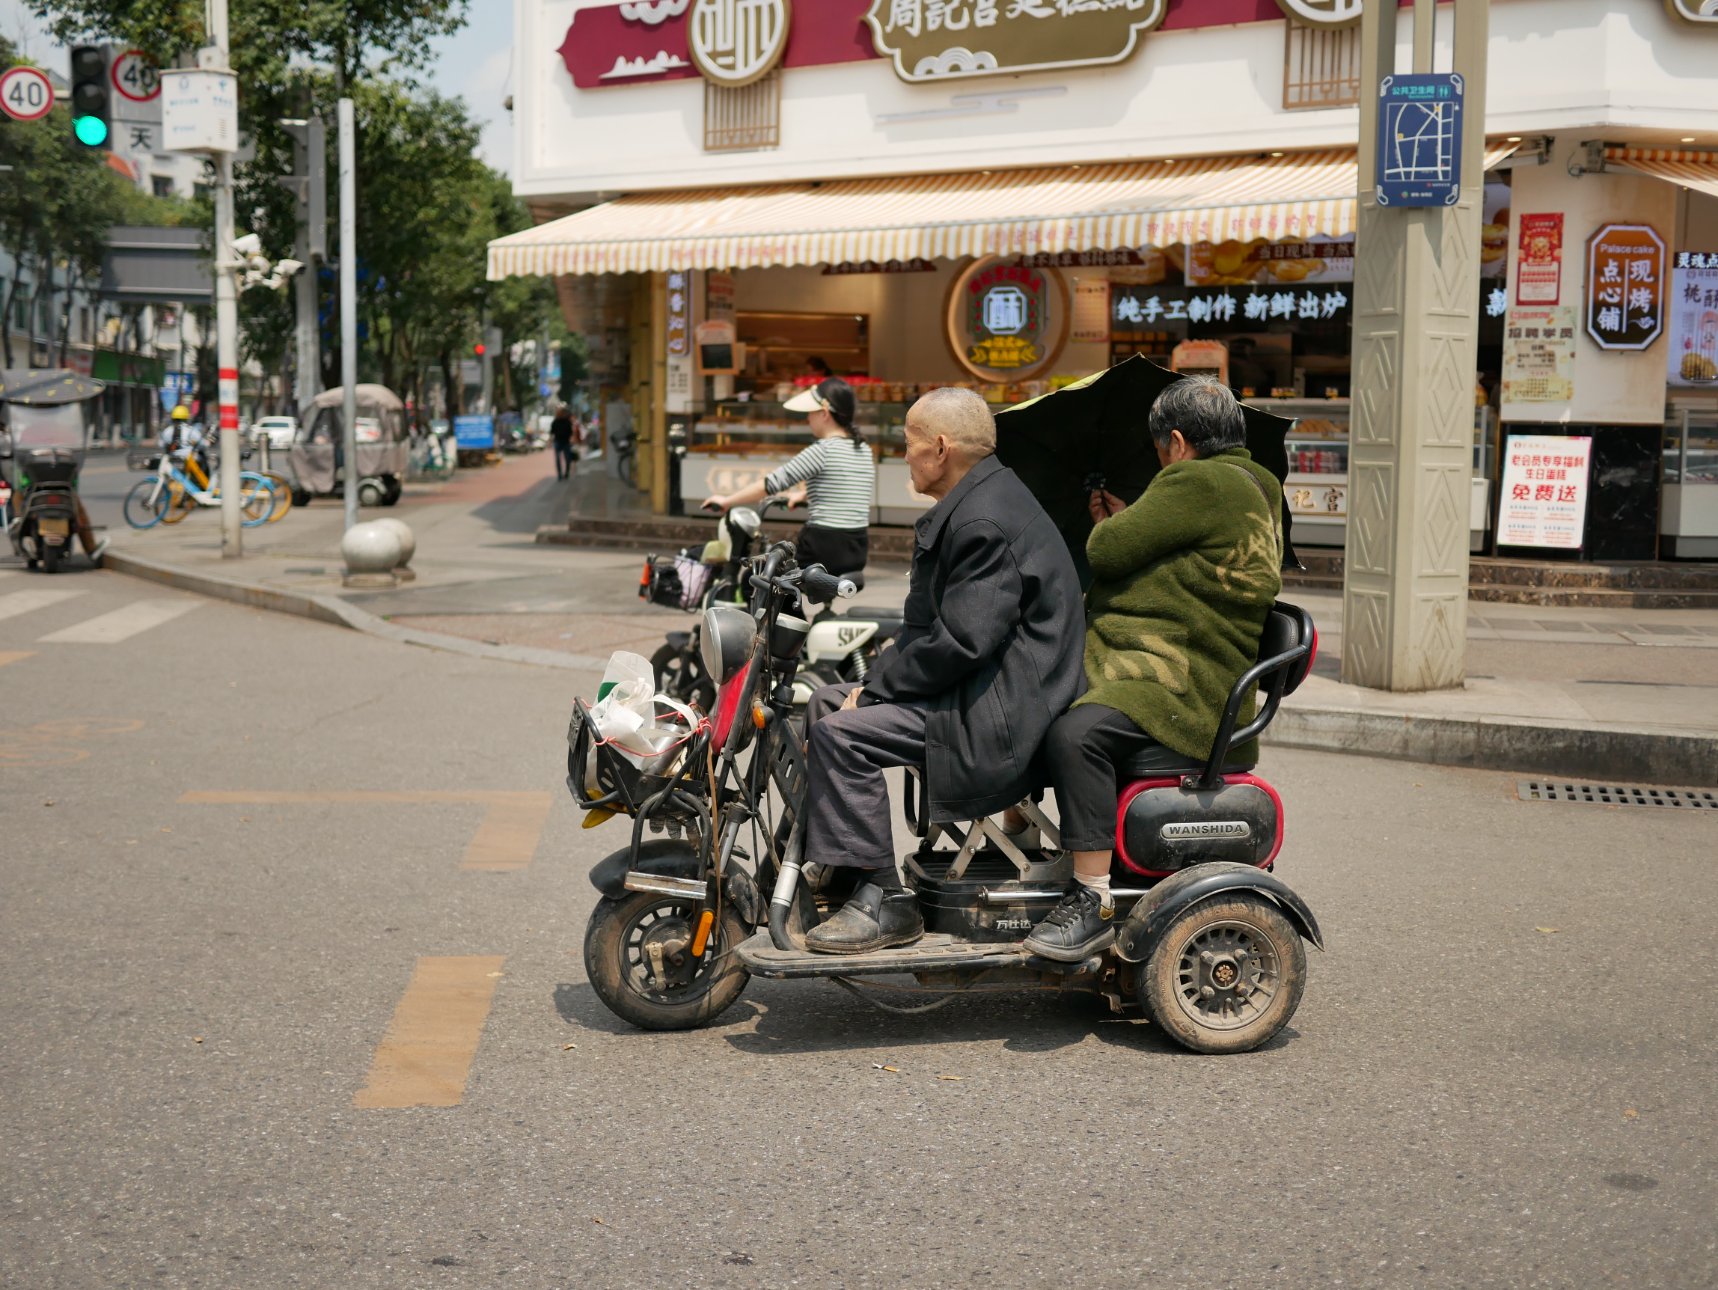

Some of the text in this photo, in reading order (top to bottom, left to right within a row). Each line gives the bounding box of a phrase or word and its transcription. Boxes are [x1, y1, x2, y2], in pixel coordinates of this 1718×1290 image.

[9, 82, 43, 106] 40
[1596, 258, 1622, 332] 点心铺
[1628, 259, 1655, 313] 现烤
[1118, 290, 1348, 323] 纯手工制作 新鲜出炉
[1526, 469, 1567, 480] 生日蛋糕
[1512, 484, 1577, 502] 免费送
[1169, 825, 1244, 835] WANSHIDA
[996, 920, 1032, 929] 万仕达
